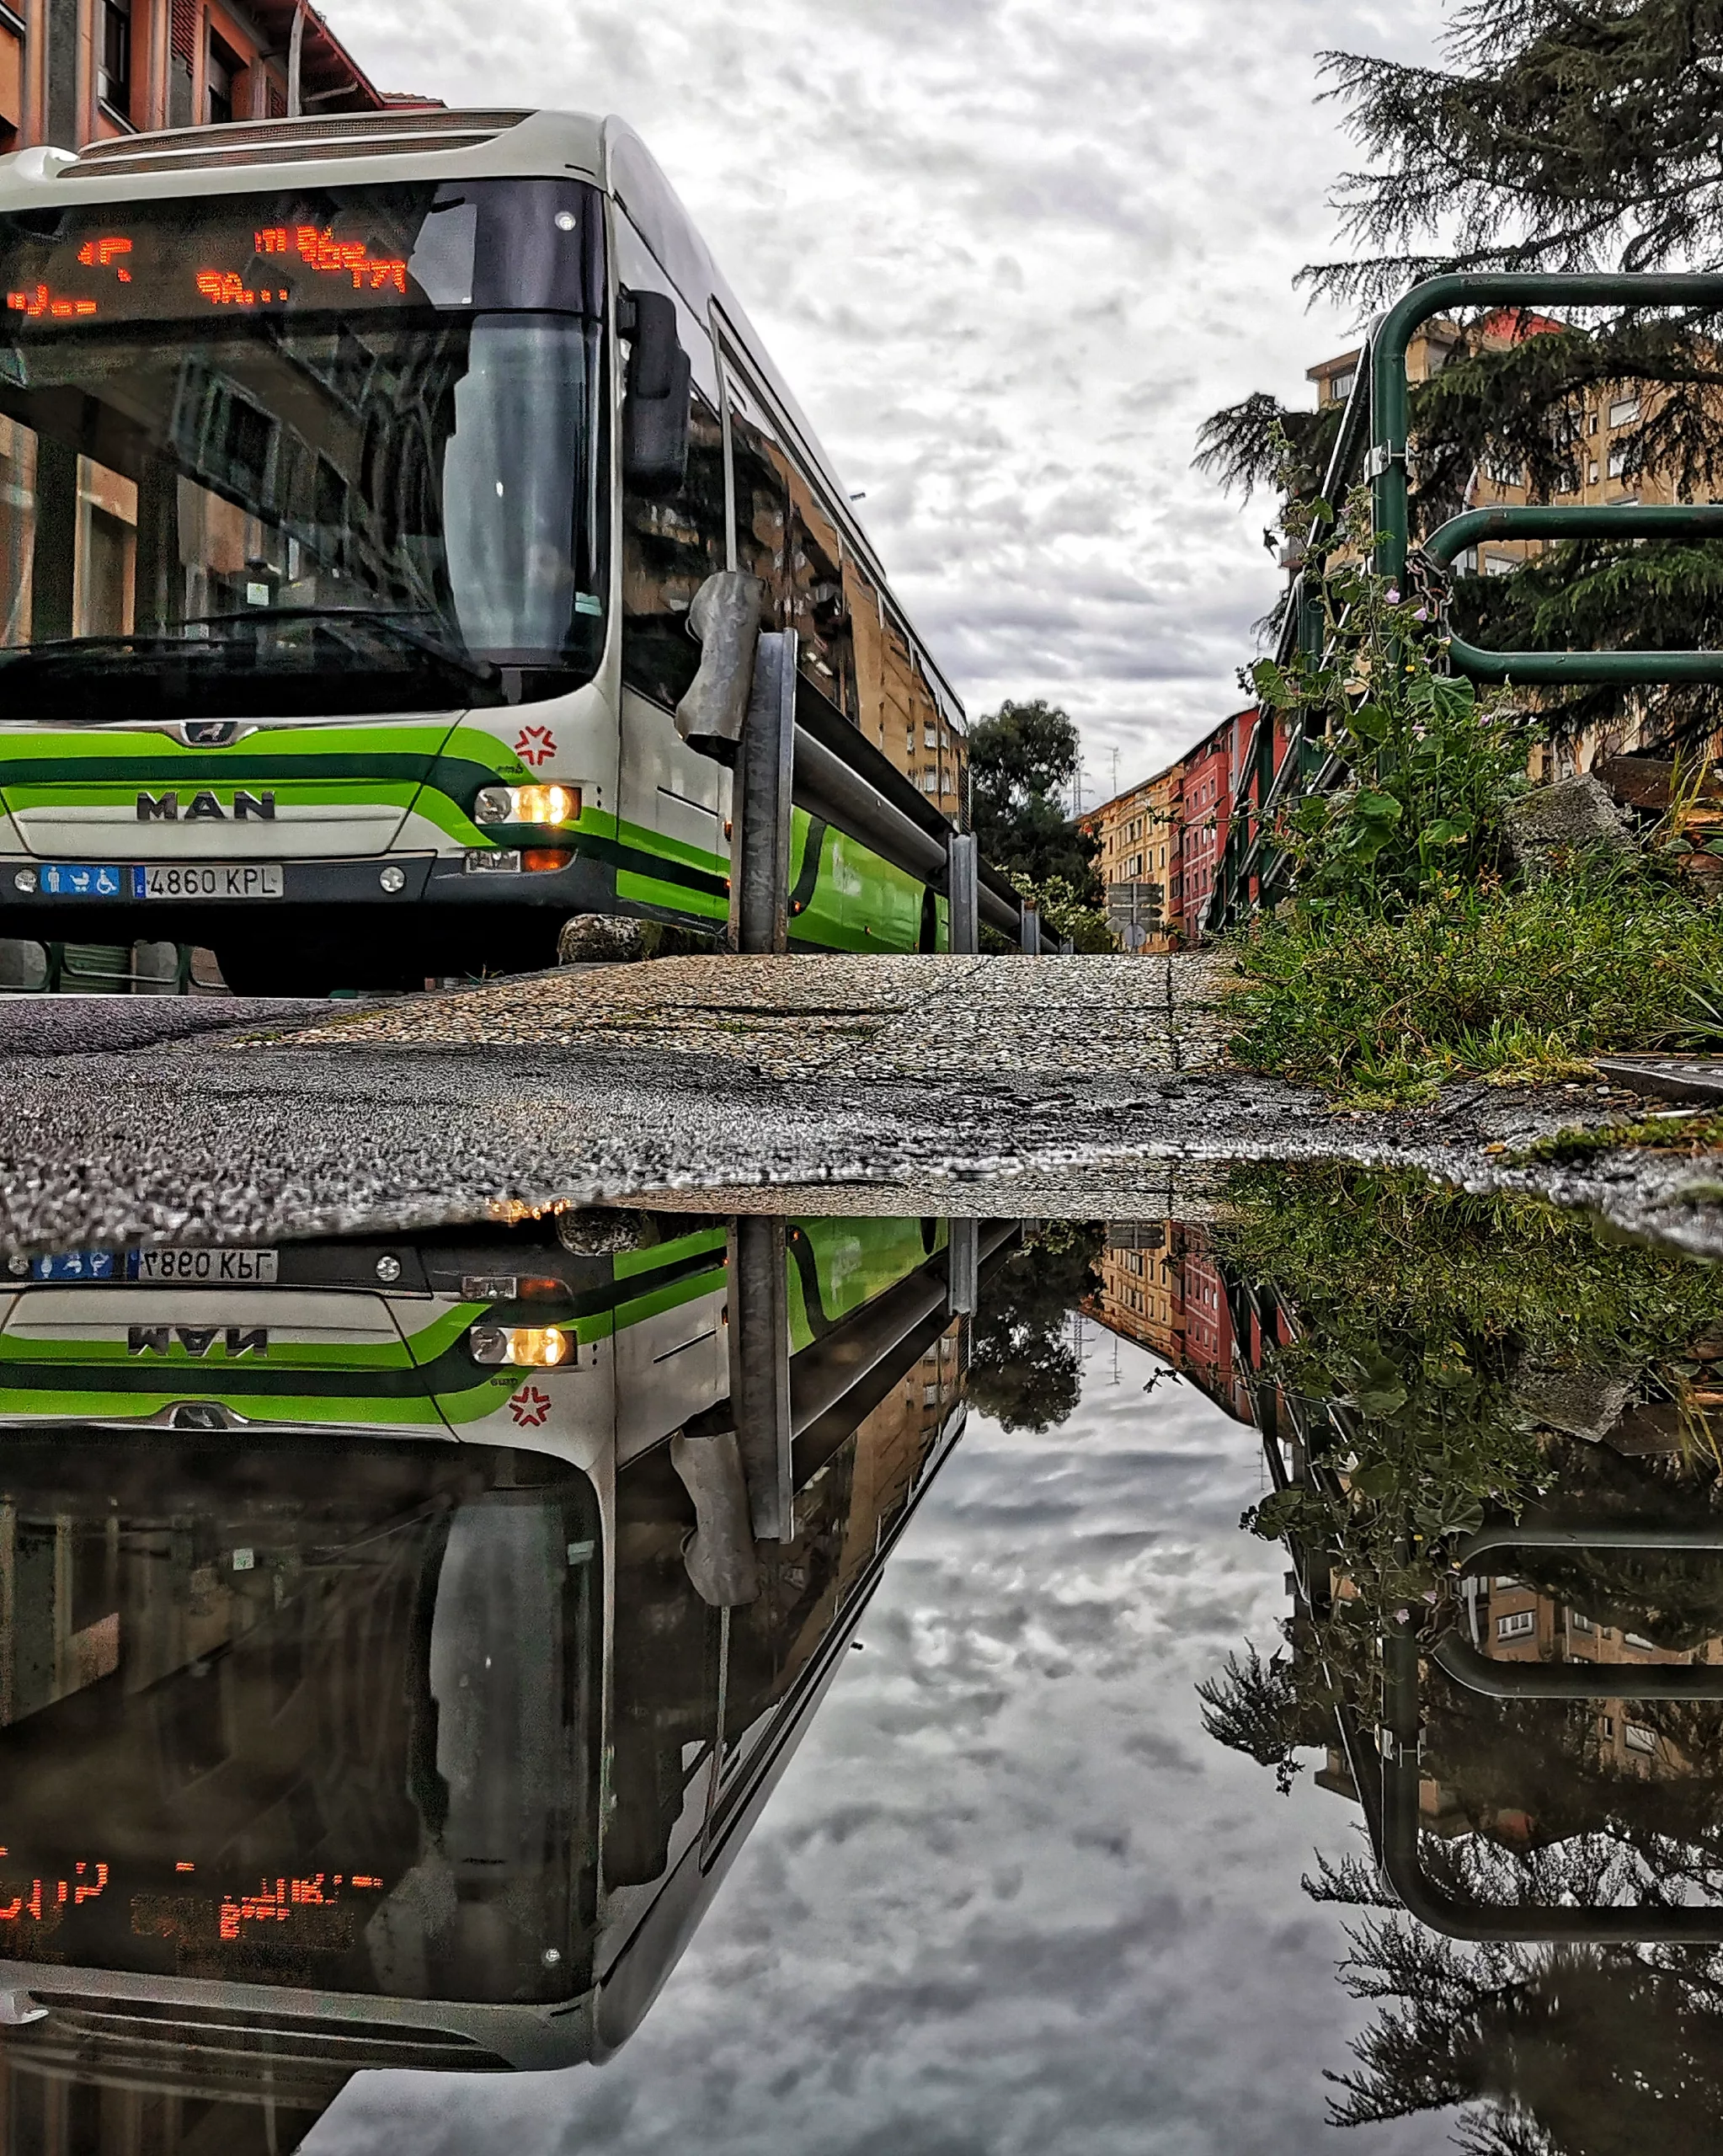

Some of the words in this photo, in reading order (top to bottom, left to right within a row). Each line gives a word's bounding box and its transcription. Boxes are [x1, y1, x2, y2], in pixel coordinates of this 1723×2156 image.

[136, 790, 275, 819] MAN
[150, 869, 216, 894] 4860
[226, 868, 276, 894] KPL
